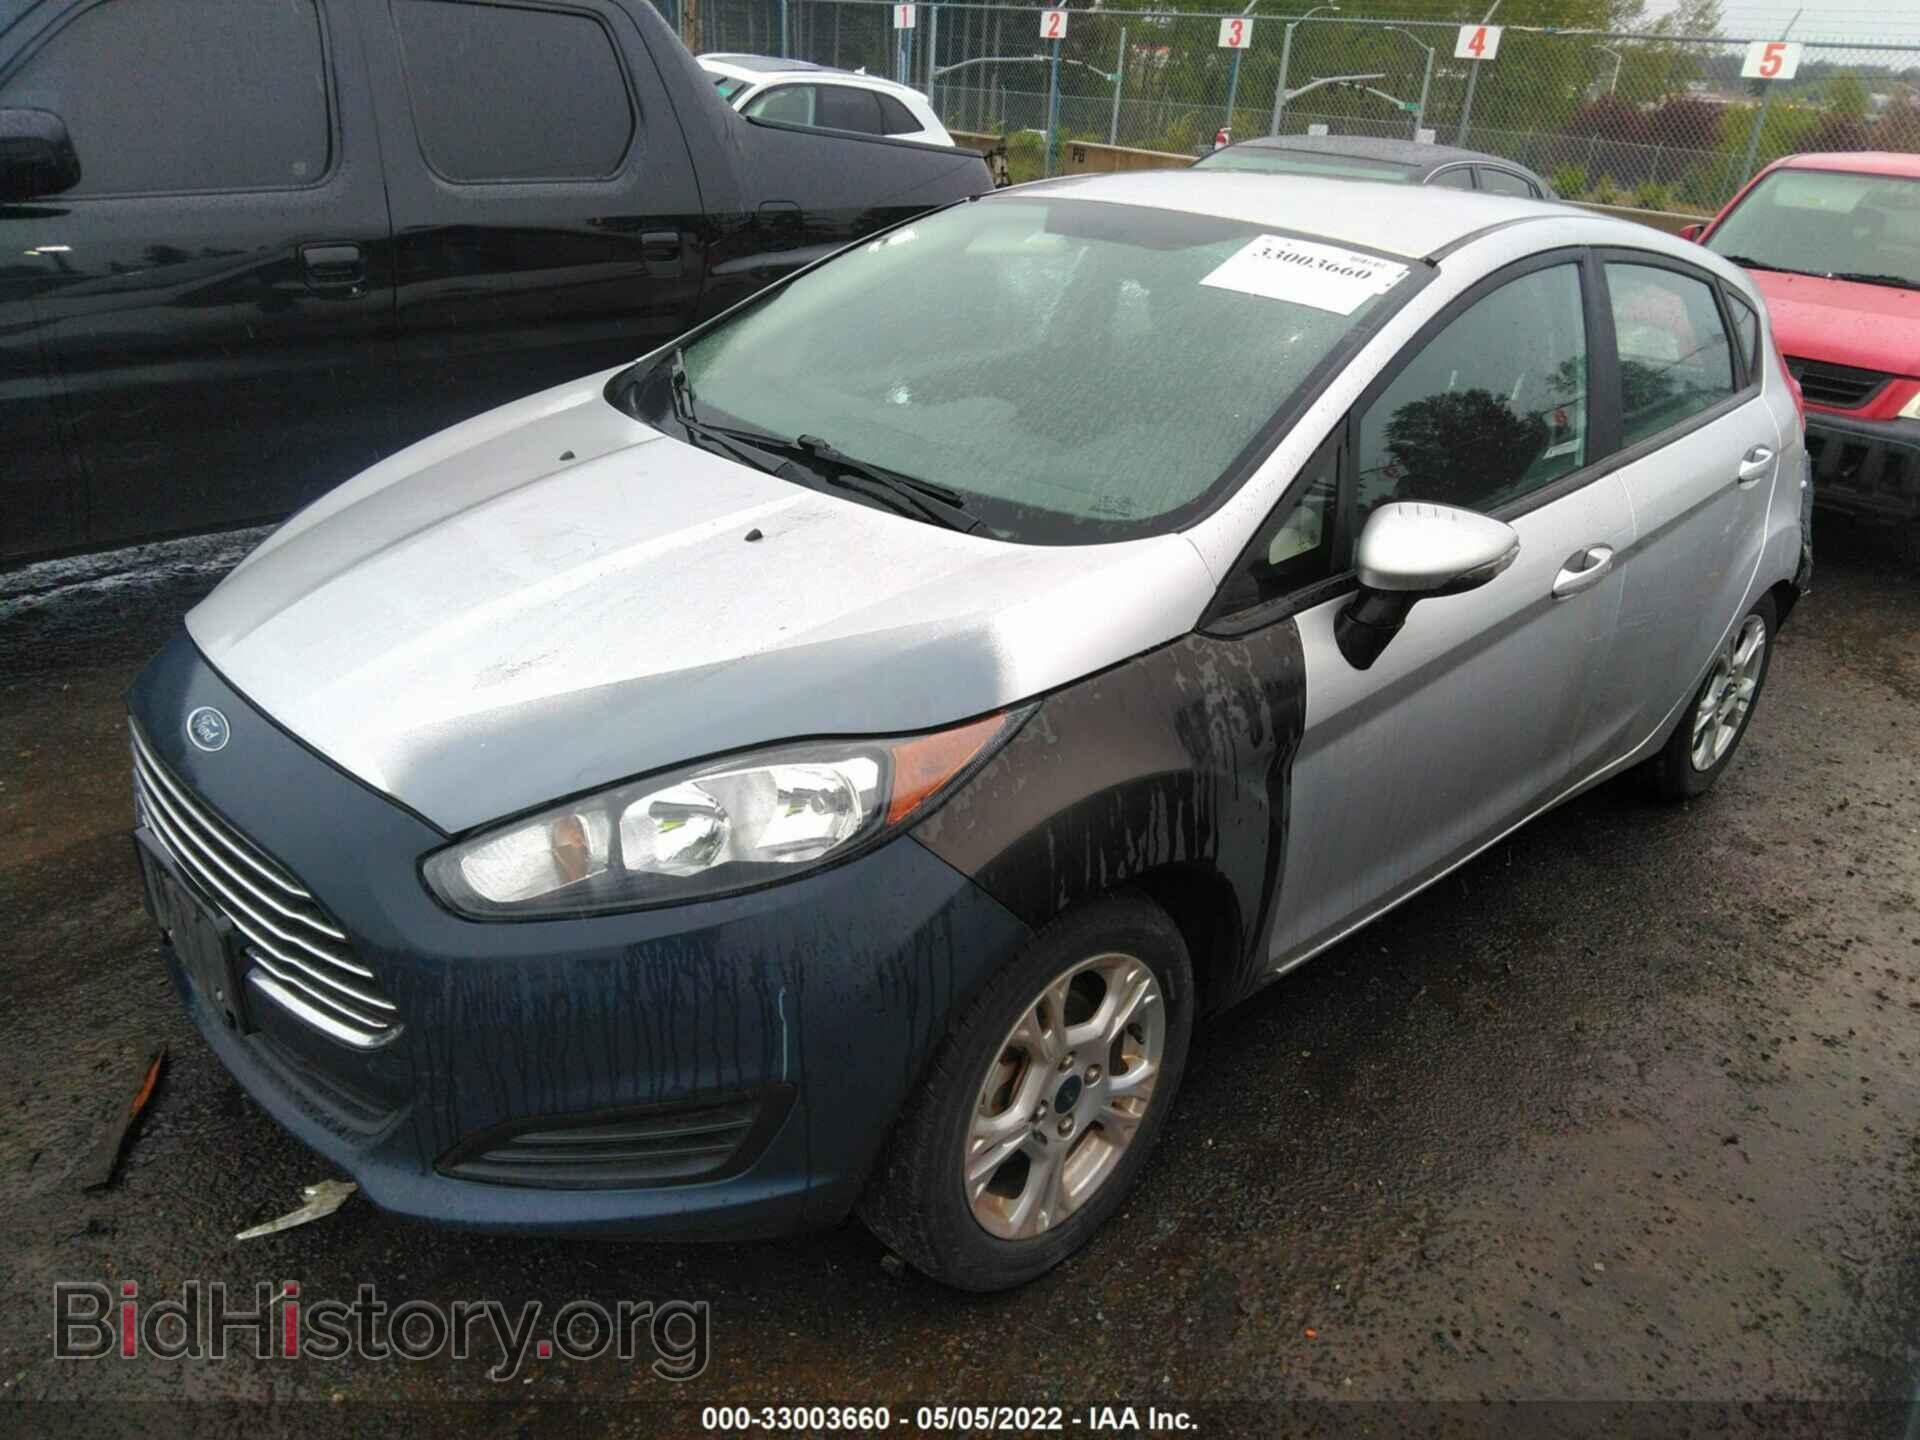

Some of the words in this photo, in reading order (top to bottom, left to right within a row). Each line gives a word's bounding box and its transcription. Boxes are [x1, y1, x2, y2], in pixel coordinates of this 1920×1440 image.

[901, 6, 908, 27] 1
[1047, 12, 1061, 37] 2
[1228, 20, 1243, 46] 3
[1468, 27, 1486, 57] 4
[1759, 43, 1786, 78] 5
[1252, 247, 1373, 281] 33003660
